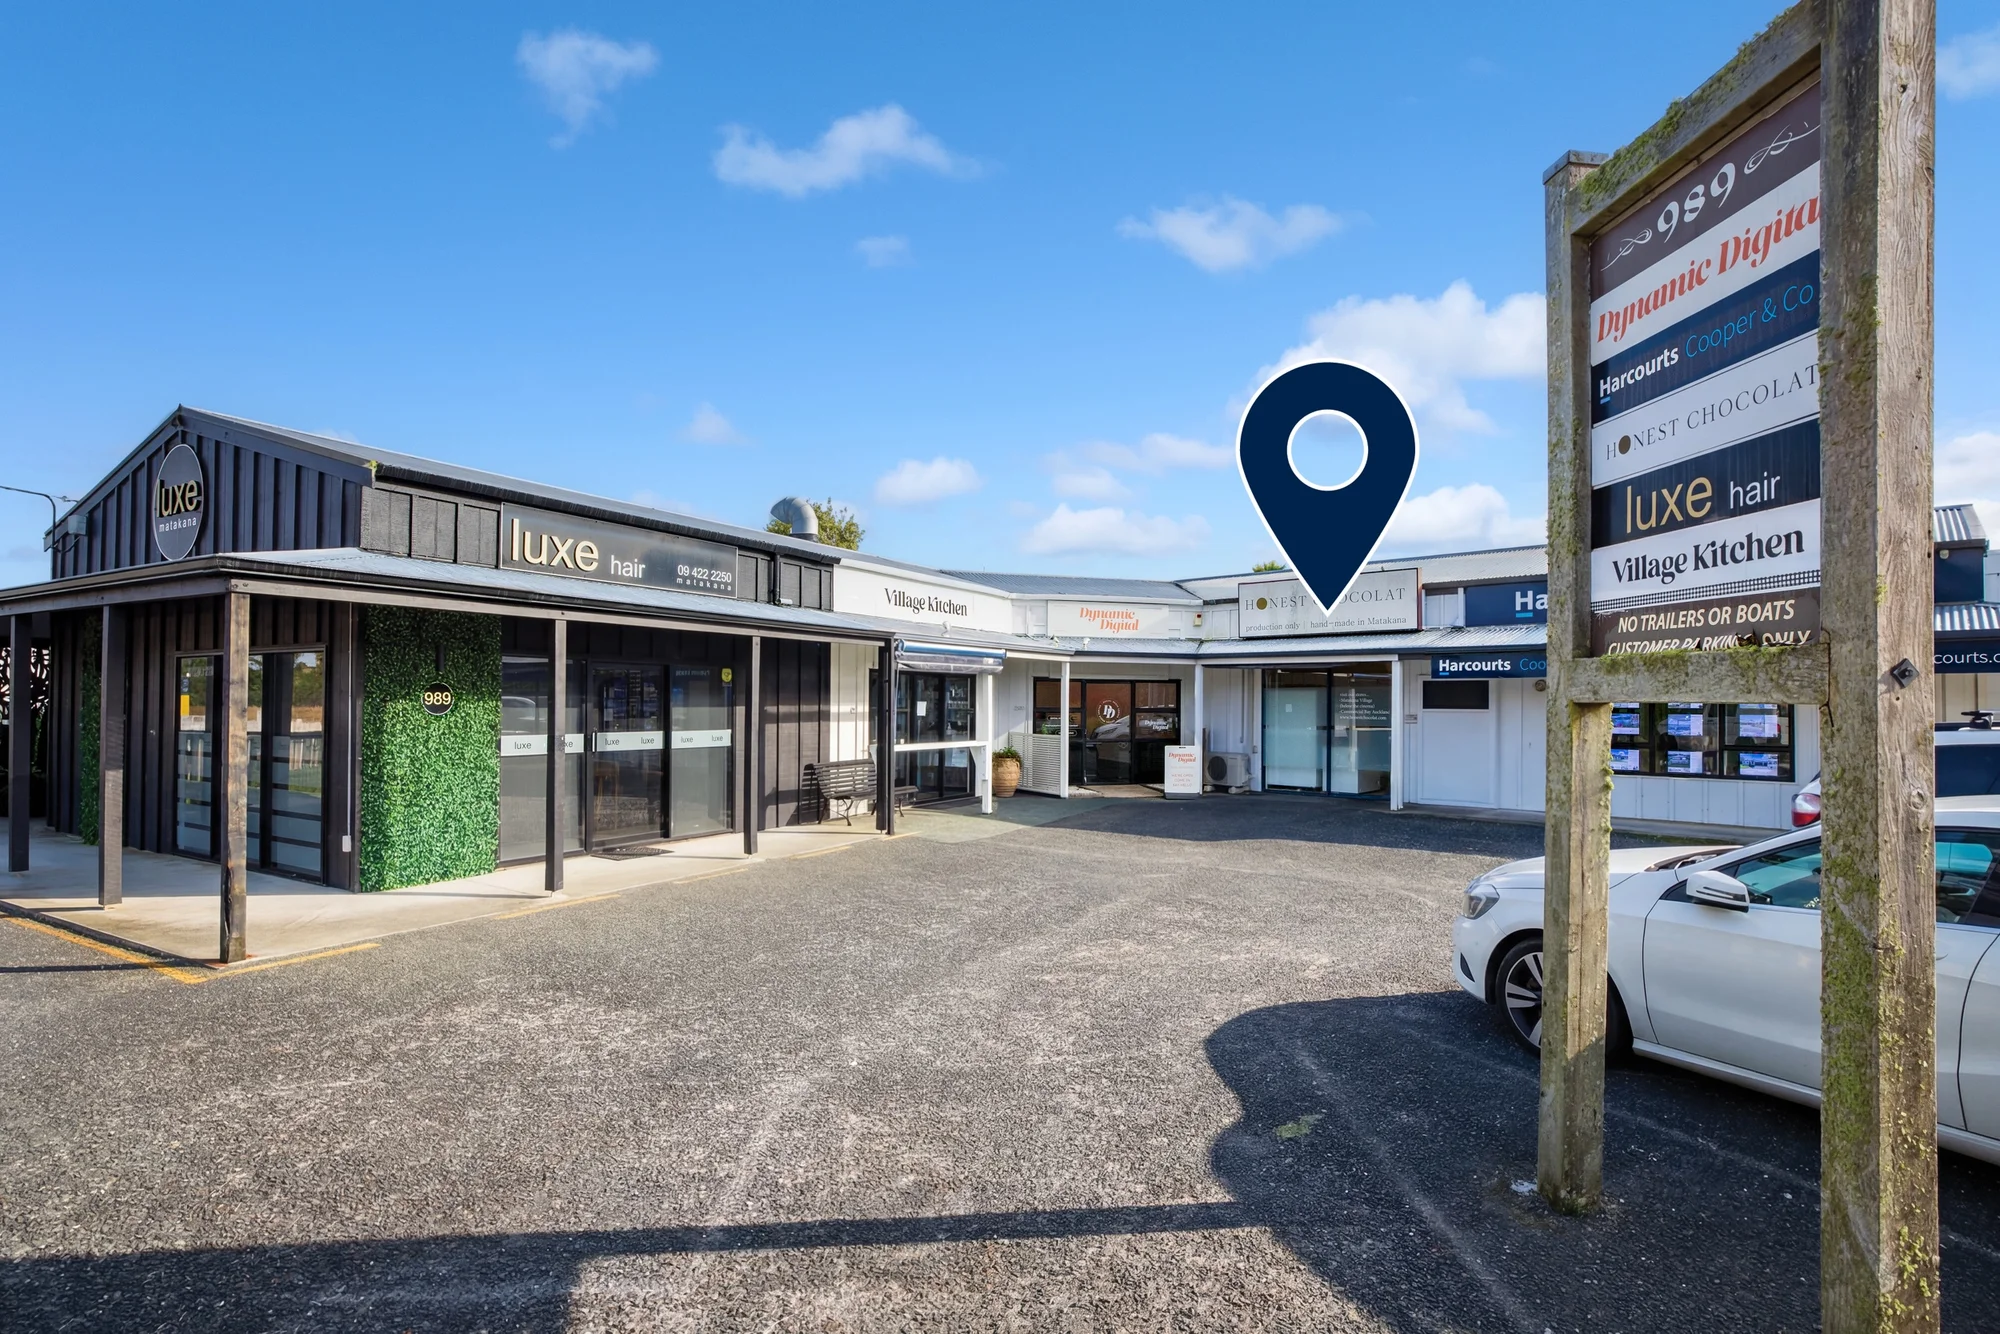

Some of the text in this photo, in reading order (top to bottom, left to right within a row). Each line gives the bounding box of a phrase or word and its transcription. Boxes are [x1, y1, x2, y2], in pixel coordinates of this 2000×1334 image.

[1657, 162, 1736, 243] 989
[1597, 195, 1820, 342] Dynamic Digita
[1600, 285, 1814, 398] Harcourts Cooper & Co
[1606, 363, 1819, 460] HONEST CHOCOLAT
[157, 480, 198, 518] luxe
[1626, 471, 1780, 534] luxe hair
[158, 517, 197, 532] matakana
[511, 518, 646, 578] luxe hair
[1613, 530, 1804, 585] Village Kitchen
[677, 564, 732, 583] 09 422 2250
[676, 577, 732, 590] matakana
[884, 588, 967, 616] Village Kitchen
[1245, 588, 1406, 610] HONEST OCOLAT
[1080, 607, 1135, 622] Dynamic
[1245, 623, 1283, 632] production
[1285, 622, 1300, 631] only
[1310, 619, 1355, 629] hand-made
[1367, 616, 1406, 626] Matakana
[1618, 599, 1795, 633] NO TRAILERS OR BOATS
[1100, 619, 1139, 633] Digital
[1608, 638, 1680, 656] CUSTOMER
[1439, 658, 1547, 671] Harcourts Coo
[424, 692, 451, 705] 989
[514, 742, 532, 750] luxe
[605, 738, 620, 746] luxe
[681, 735, 694, 743] luxe
